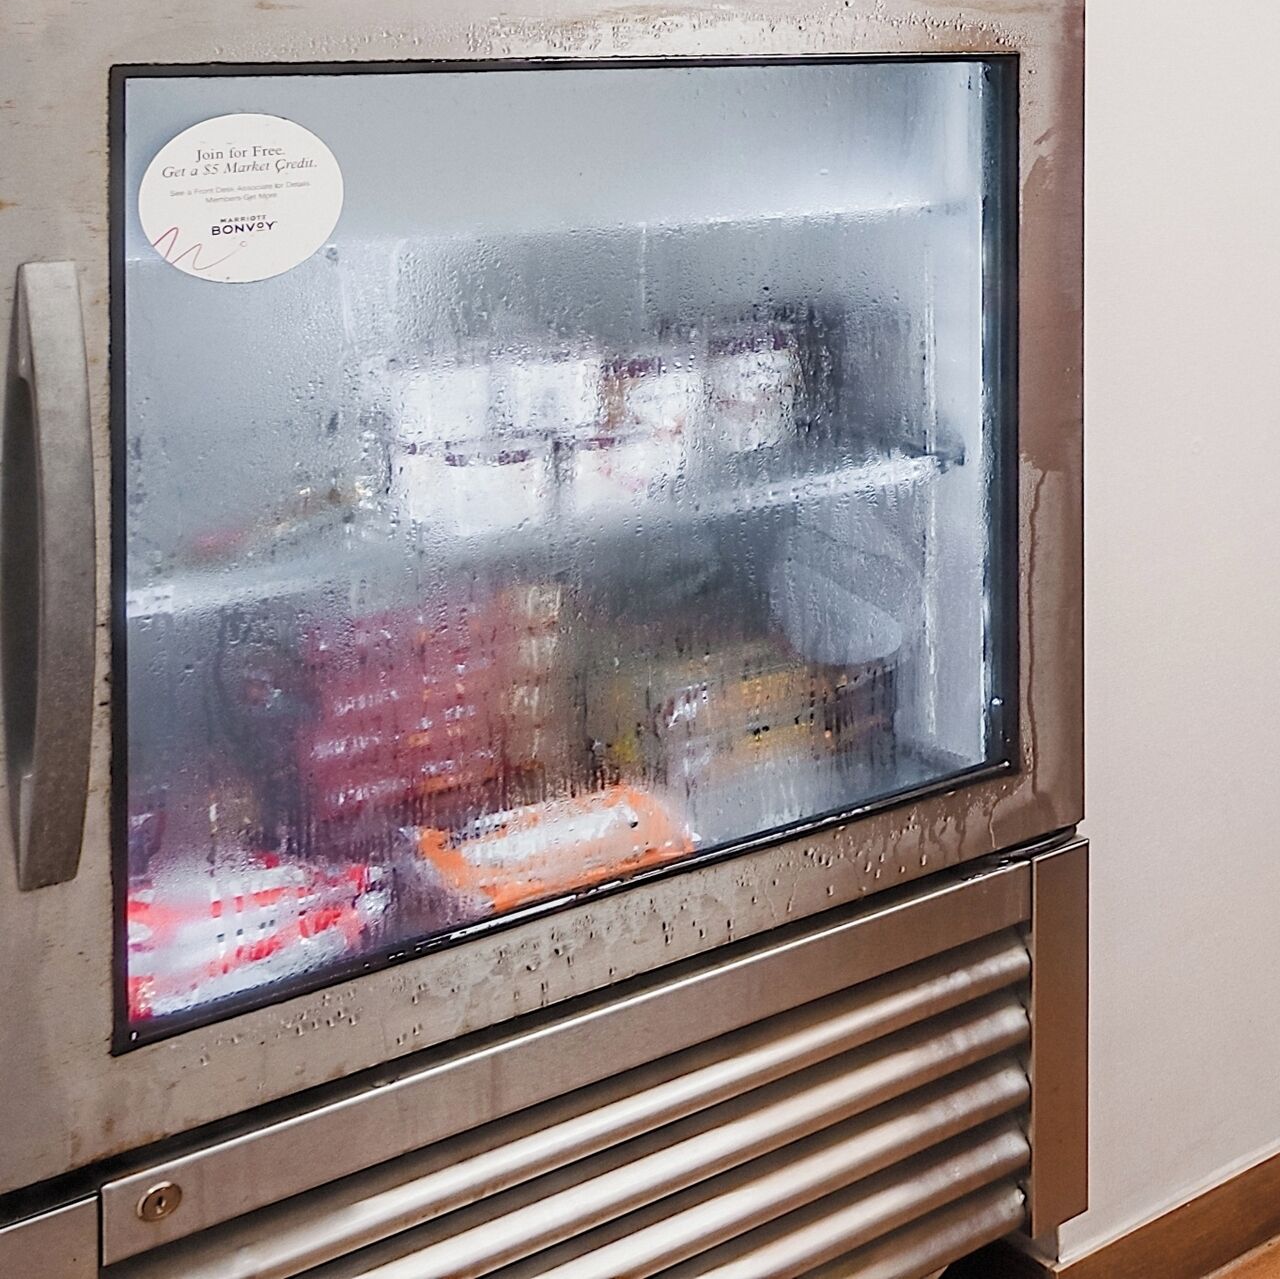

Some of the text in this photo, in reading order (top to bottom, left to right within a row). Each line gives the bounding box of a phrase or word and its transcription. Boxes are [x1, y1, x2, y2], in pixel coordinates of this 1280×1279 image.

[195, 148, 224, 163] Join
[229, 146, 248, 158] for
[162, 166, 188, 178] Get
[190, 168, 198, 176] a
[223, 160, 270, 175] Market
[220, 214, 267, 223] MARRIOTT
